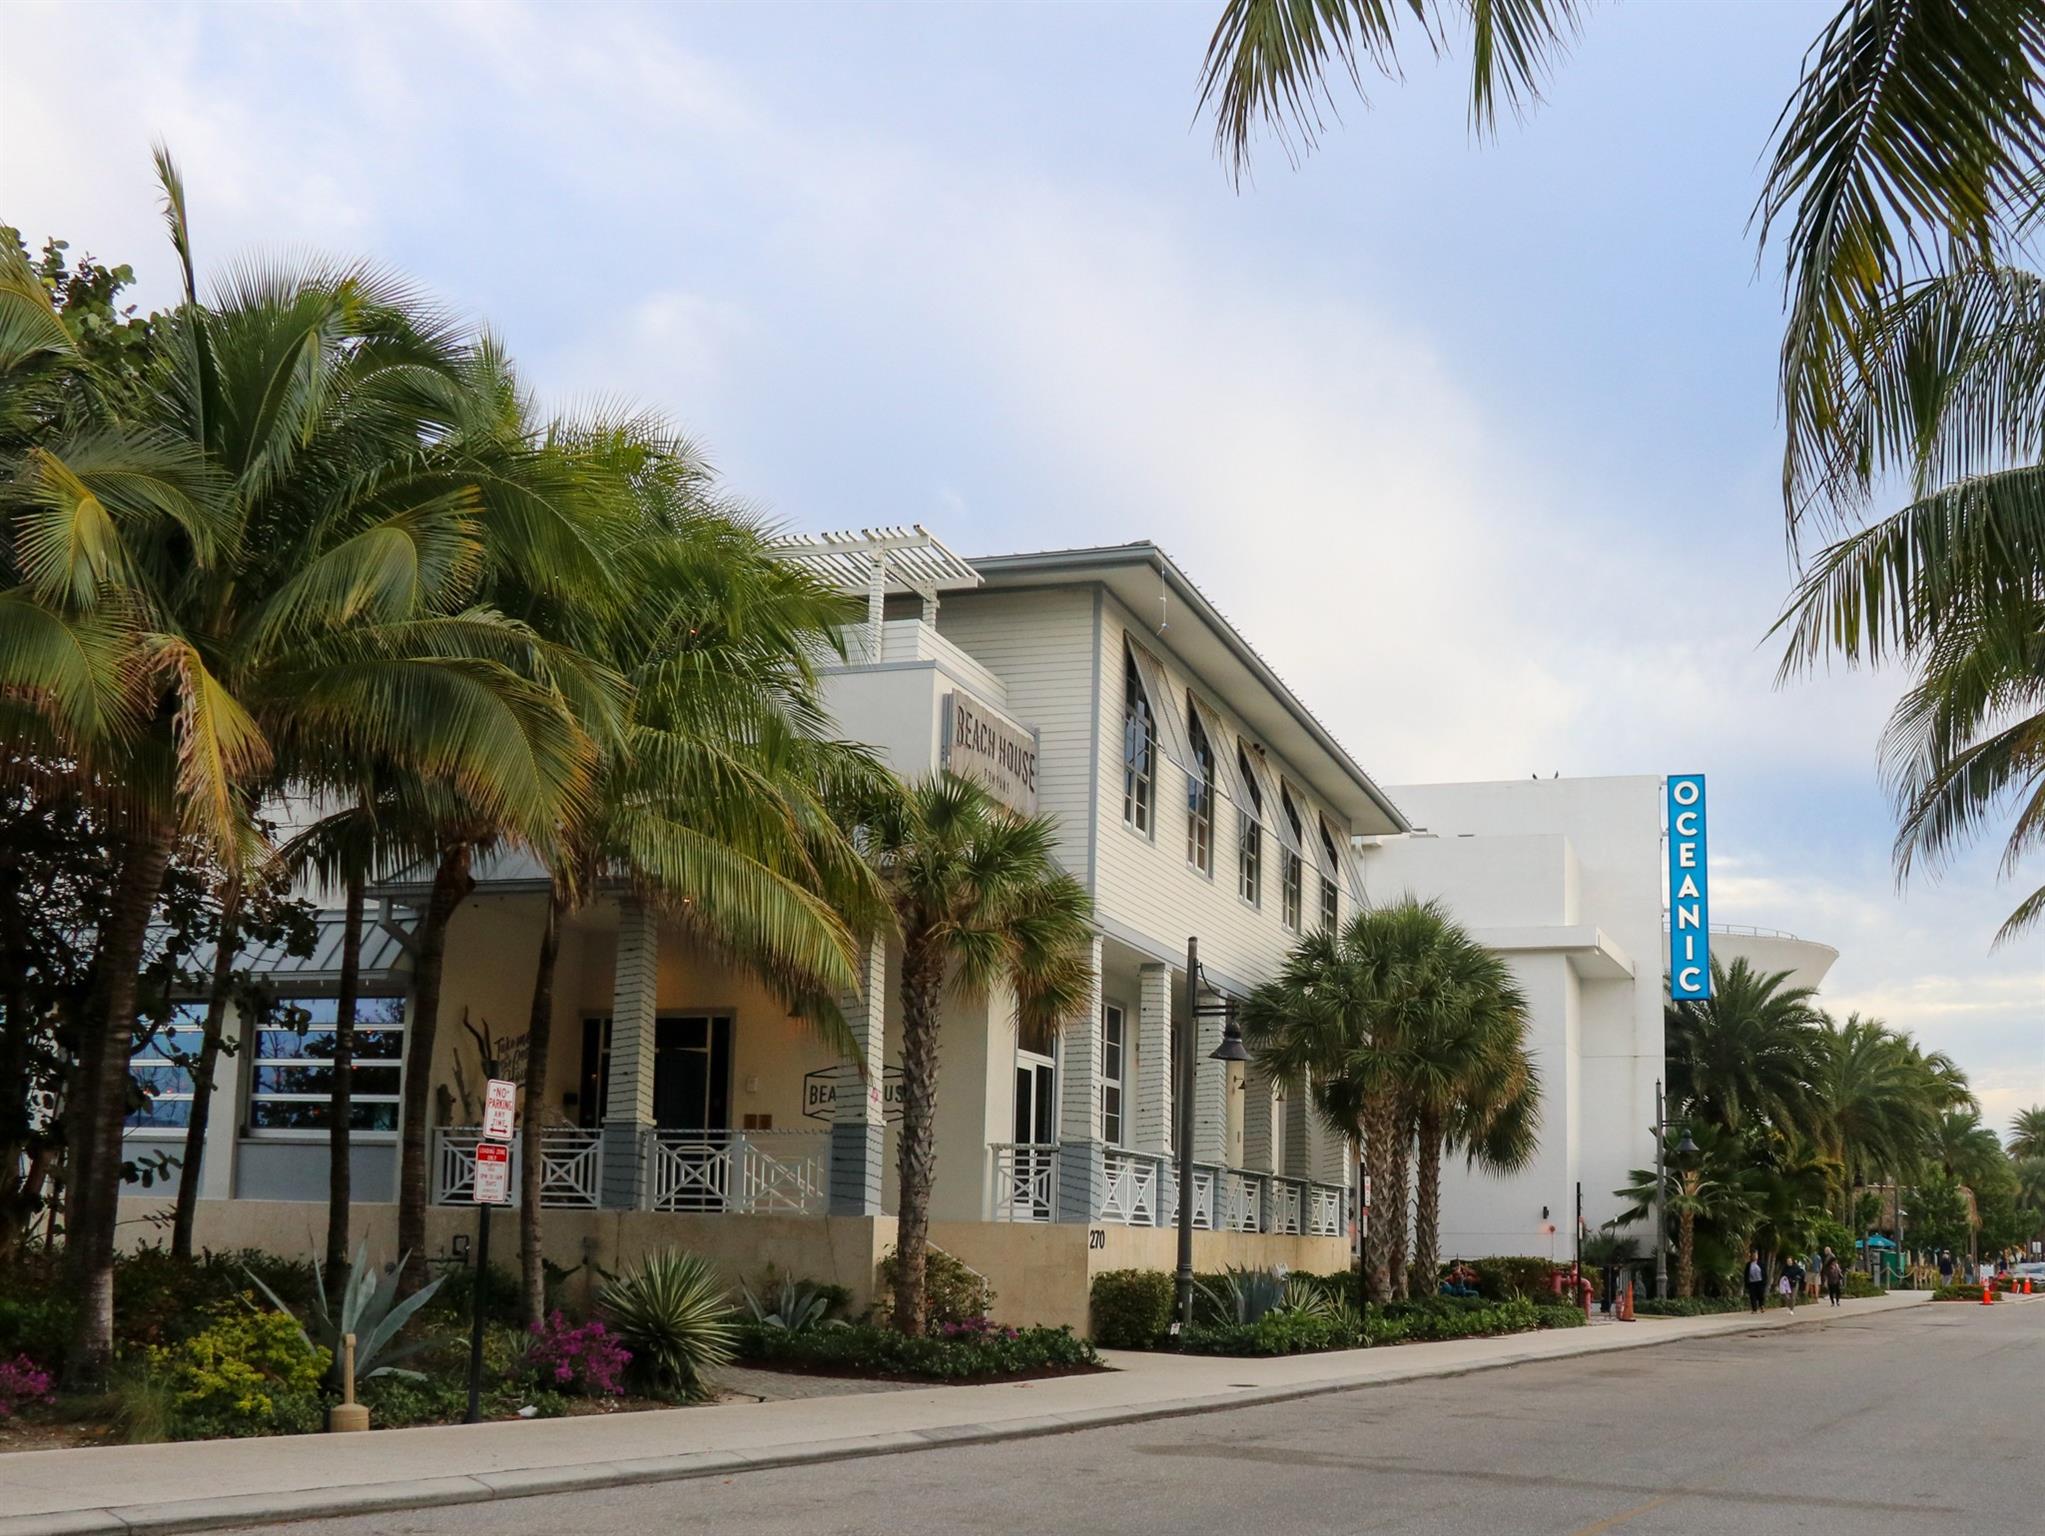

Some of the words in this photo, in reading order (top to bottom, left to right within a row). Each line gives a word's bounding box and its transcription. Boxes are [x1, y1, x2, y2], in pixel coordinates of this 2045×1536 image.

[956, 705, 996, 760] BEACH
[999, 735, 1036, 794] HOUSE
[1673, 780, 1702, 993] OCEANIC
[495, 1087, 507, 1099] NO
[809, 1085, 837, 1105] BEA
[487, 1098, 513, 1112] PARKING
[1089, 1229, 1105, 1250] 270
